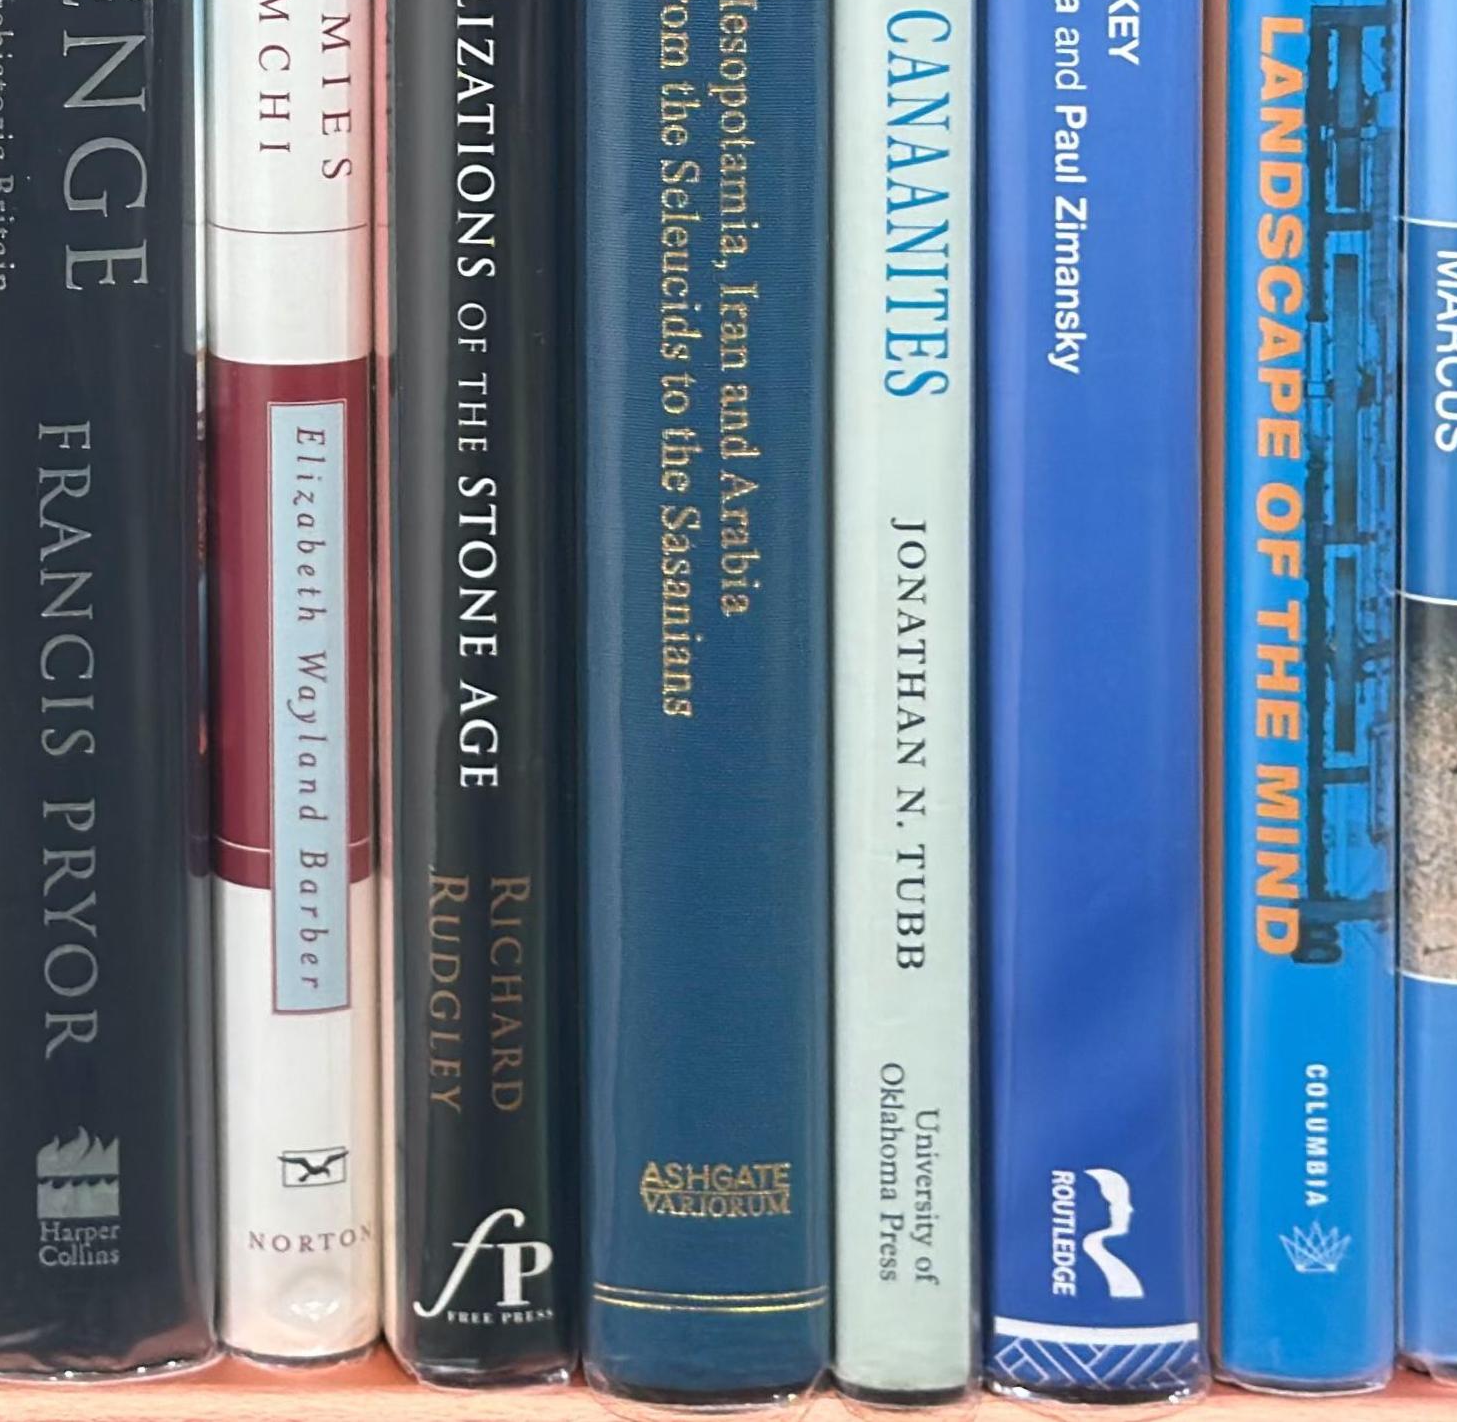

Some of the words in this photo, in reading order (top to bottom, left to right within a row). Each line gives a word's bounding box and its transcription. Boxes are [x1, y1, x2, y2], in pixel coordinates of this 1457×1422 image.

[659, 80, 702, 148] the
[1053, 27, 1089, 91] and
[883, 9, 953, 398] CANAANITES
[1053, 104, 1090, 185] Paul
[659, 157, 704, 364] Seleucids
[1045, 194, 1089, 375] Zimansky
[1256, 15, 1306, 460] LANDSCAPE
[456, 302, 488, 354] OF
[660, 370, 692, 416] to
[718, 280, 759, 373] Iran
[456, 371, 488, 453] THE
[659, 427, 704, 497] the
[718, 380, 762, 462] and
[38, 421, 96, 758] FRANCIS
[294, 425, 329, 624] Elizabeth
[457, 476, 499, 659] STONE
[719, 469, 762, 618] Arabia
[1254, 481, 1304, 579] OF
[660, 503, 705, 719] Sasanians
[889, 517, 928, 768] JONATHAN
[1255, 599, 1302, 742] THE
[285, 649, 330, 824] Wayland
[458, 678, 500, 790] AGE
[895, 786, 928, 829] N.
[1255, 765, 1302, 956] MIND
[42, 798, 99, 1060] PRYOR
[298, 847, 330, 990] Barber
[895, 843, 928, 972] TUBB
[426, 873, 471, 1115] RUDGLEY
[488, 875, 532, 1113] RICHARD
[639, 1160, 792, 1191] ASHGATE
[878, 1061, 907, 1203] Oklahoma
[913, 1107, 942, 1248] University
[1304, 1063, 1329, 1208] COLUMBIA
[247, 1223, 375, 1254] NORTON
[641, 1191, 793, 1217] VARIORUM
[878, 1212, 907, 1283] Press
[1050, 1168, 1078, 1298] ROUTLEDGE
[447, 1310, 495, 1326] FREE
[501, 1306, 556, 1324] PRESS
[917, 1257, 942, 1287] of
